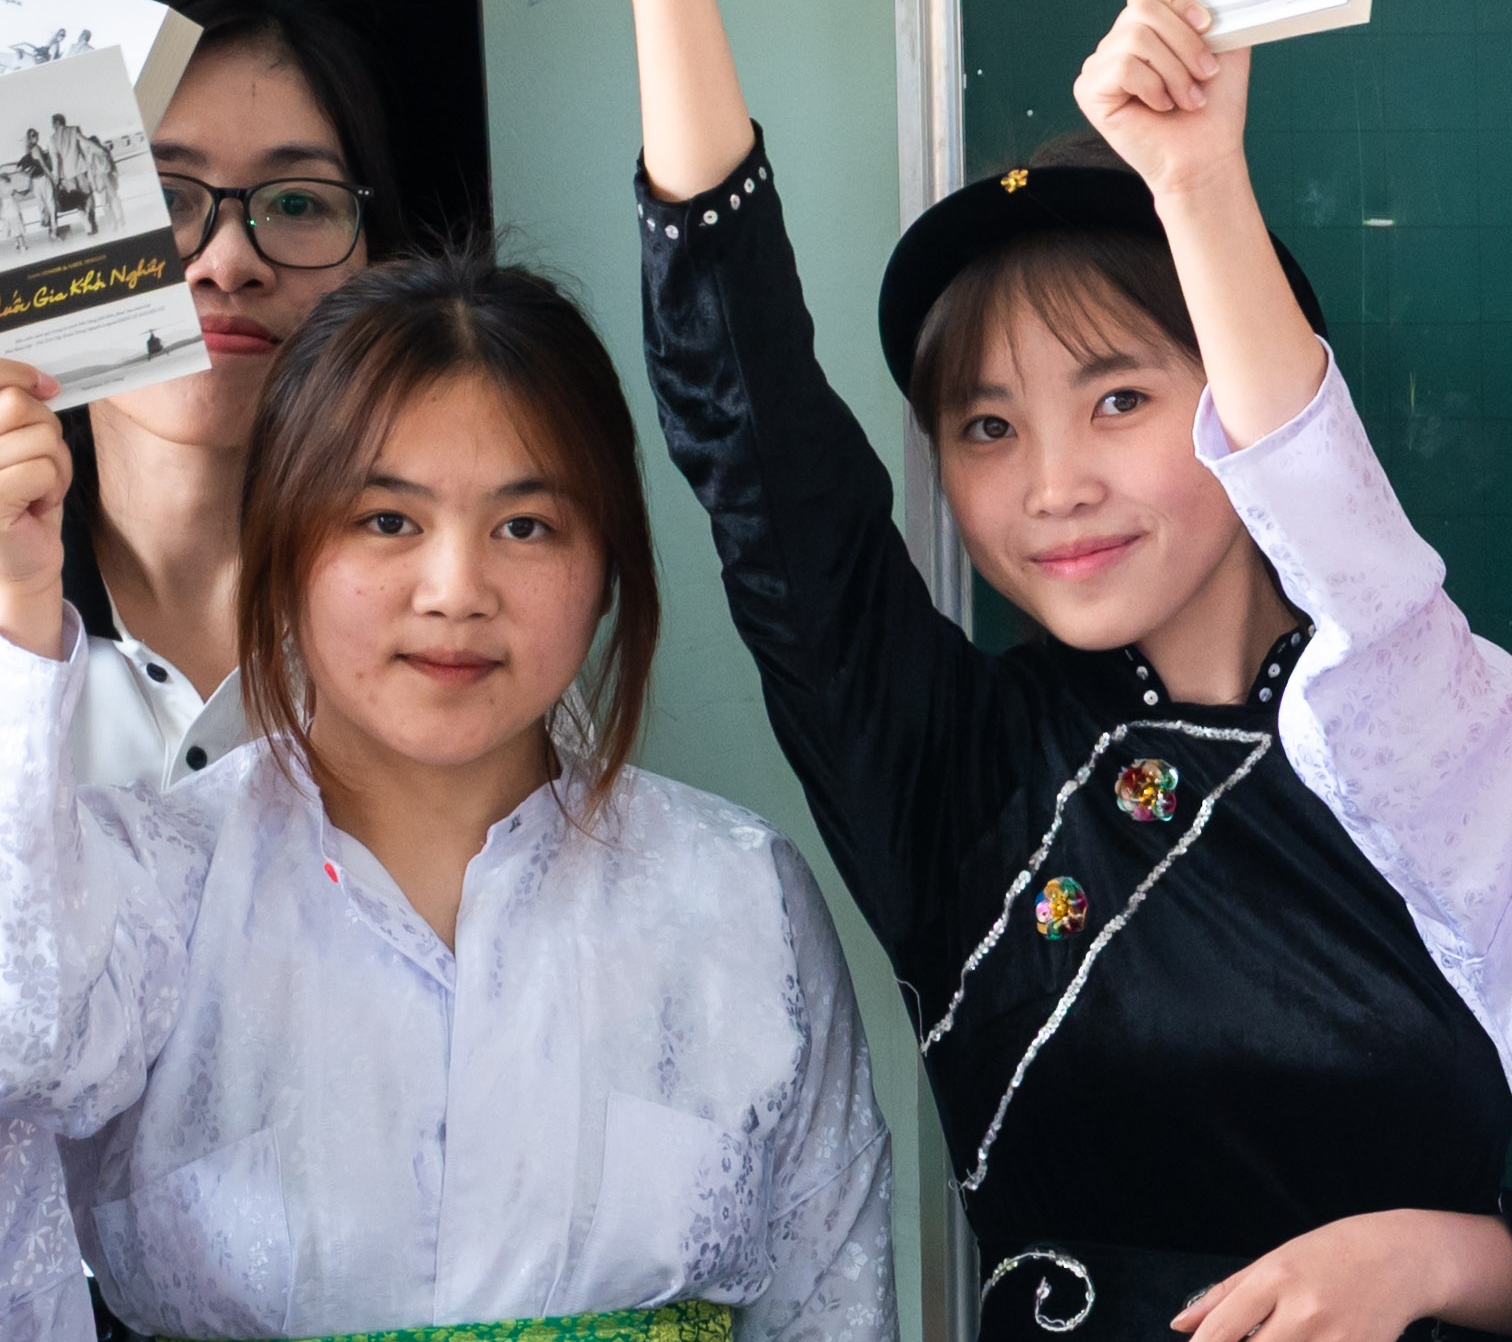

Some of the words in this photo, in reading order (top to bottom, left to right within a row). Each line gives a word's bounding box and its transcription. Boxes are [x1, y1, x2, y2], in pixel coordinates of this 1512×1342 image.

[0, 290, 31, 318] uốc
[33, 286, 68, 308] Gia
[110, 258, 166, 289] Nghiệp
